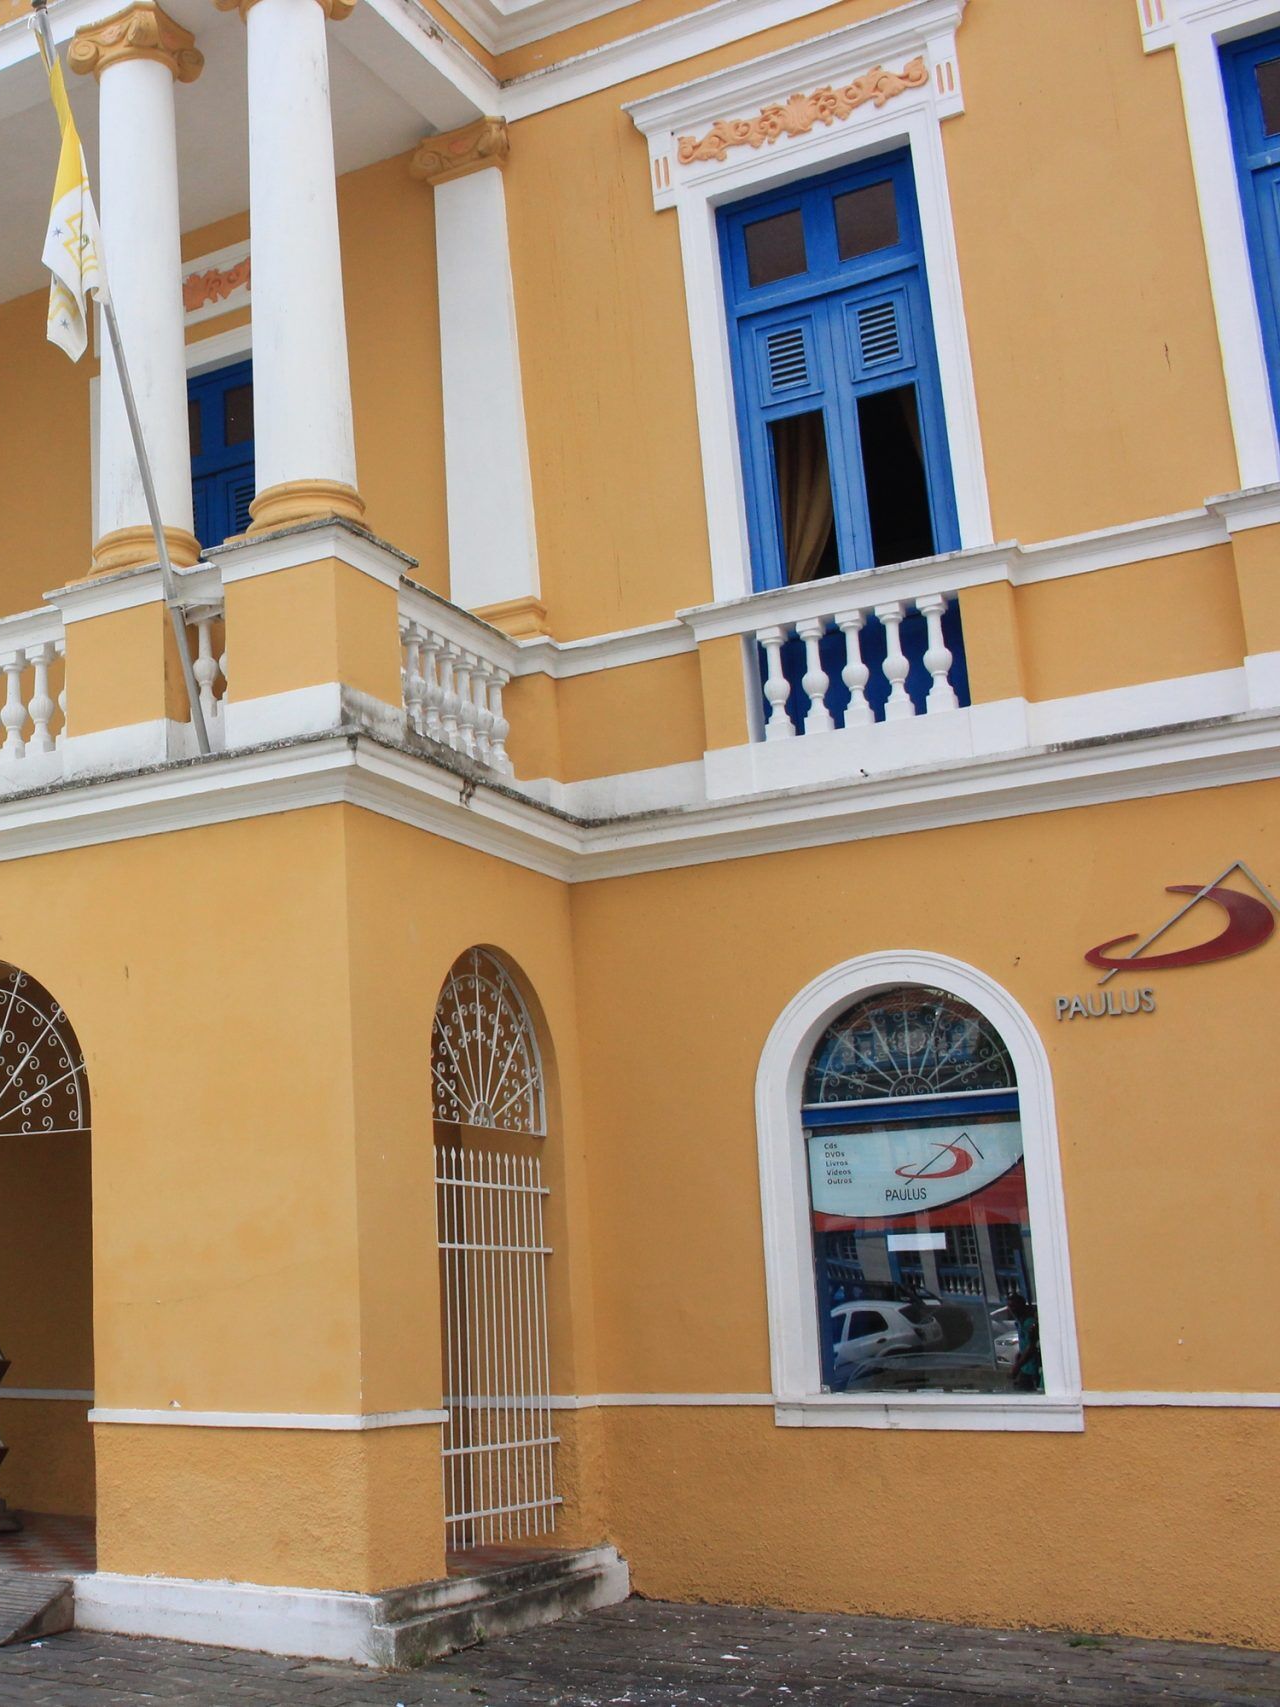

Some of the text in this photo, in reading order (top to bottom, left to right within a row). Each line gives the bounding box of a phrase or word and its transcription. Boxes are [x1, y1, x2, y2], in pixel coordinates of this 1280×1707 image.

[1055, 987, 1156, 1021] PAULUS
[827, 1177, 853, 1185] Outros
[885, 1187, 927, 1201] PAULUS
